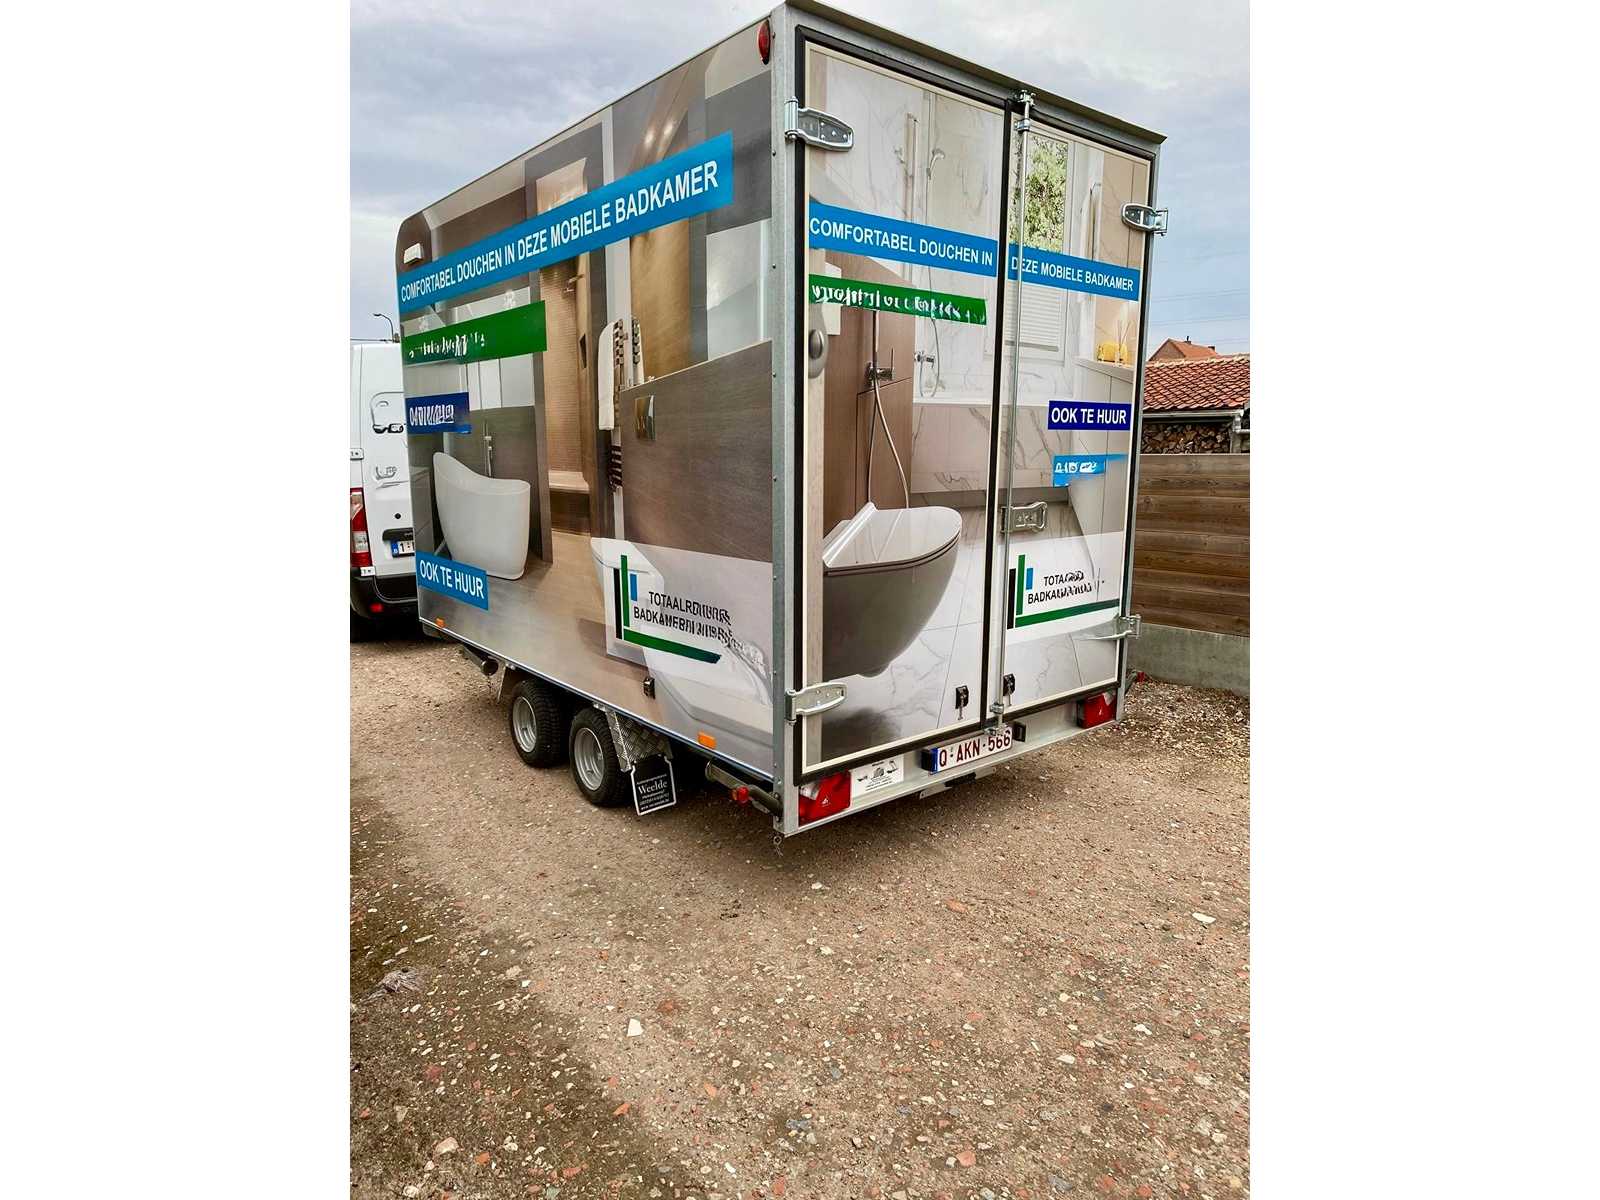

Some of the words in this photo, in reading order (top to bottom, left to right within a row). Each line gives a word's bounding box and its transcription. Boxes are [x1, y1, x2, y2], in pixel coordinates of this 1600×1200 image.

[401, 265, 456, 302] COMFORTABEL
[457, 249, 503, 282] DOUCHEN
[504, 242, 516, 266] IN
[517, 228, 548, 261] DEZE
[550, 202, 612, 249] MOBIELE
[615, 160, 719, 224] BADKAMER
[809, 217, 916, 253] COMFORTABEL
[919, 238, 979, 264] DOUCHEN
[981, 250, 993, 266] IN
[1011, 256, 1039, 274] DEZE
[1040, 261, 1083, 283] MOBIELE
[1085, 271, 1134, 292] BADKAMER
[1051, 407, 1078, 424] OOK
[1080, 408, 1095, 424] TE
[1096, 408, 1127, 424] HUUR
[419, 559, 440, 583] OOK
[439, 566, 454, 588] TE
[454, 571, 485, 600] HUUR
[638, 779, 668, 794] Weelde
